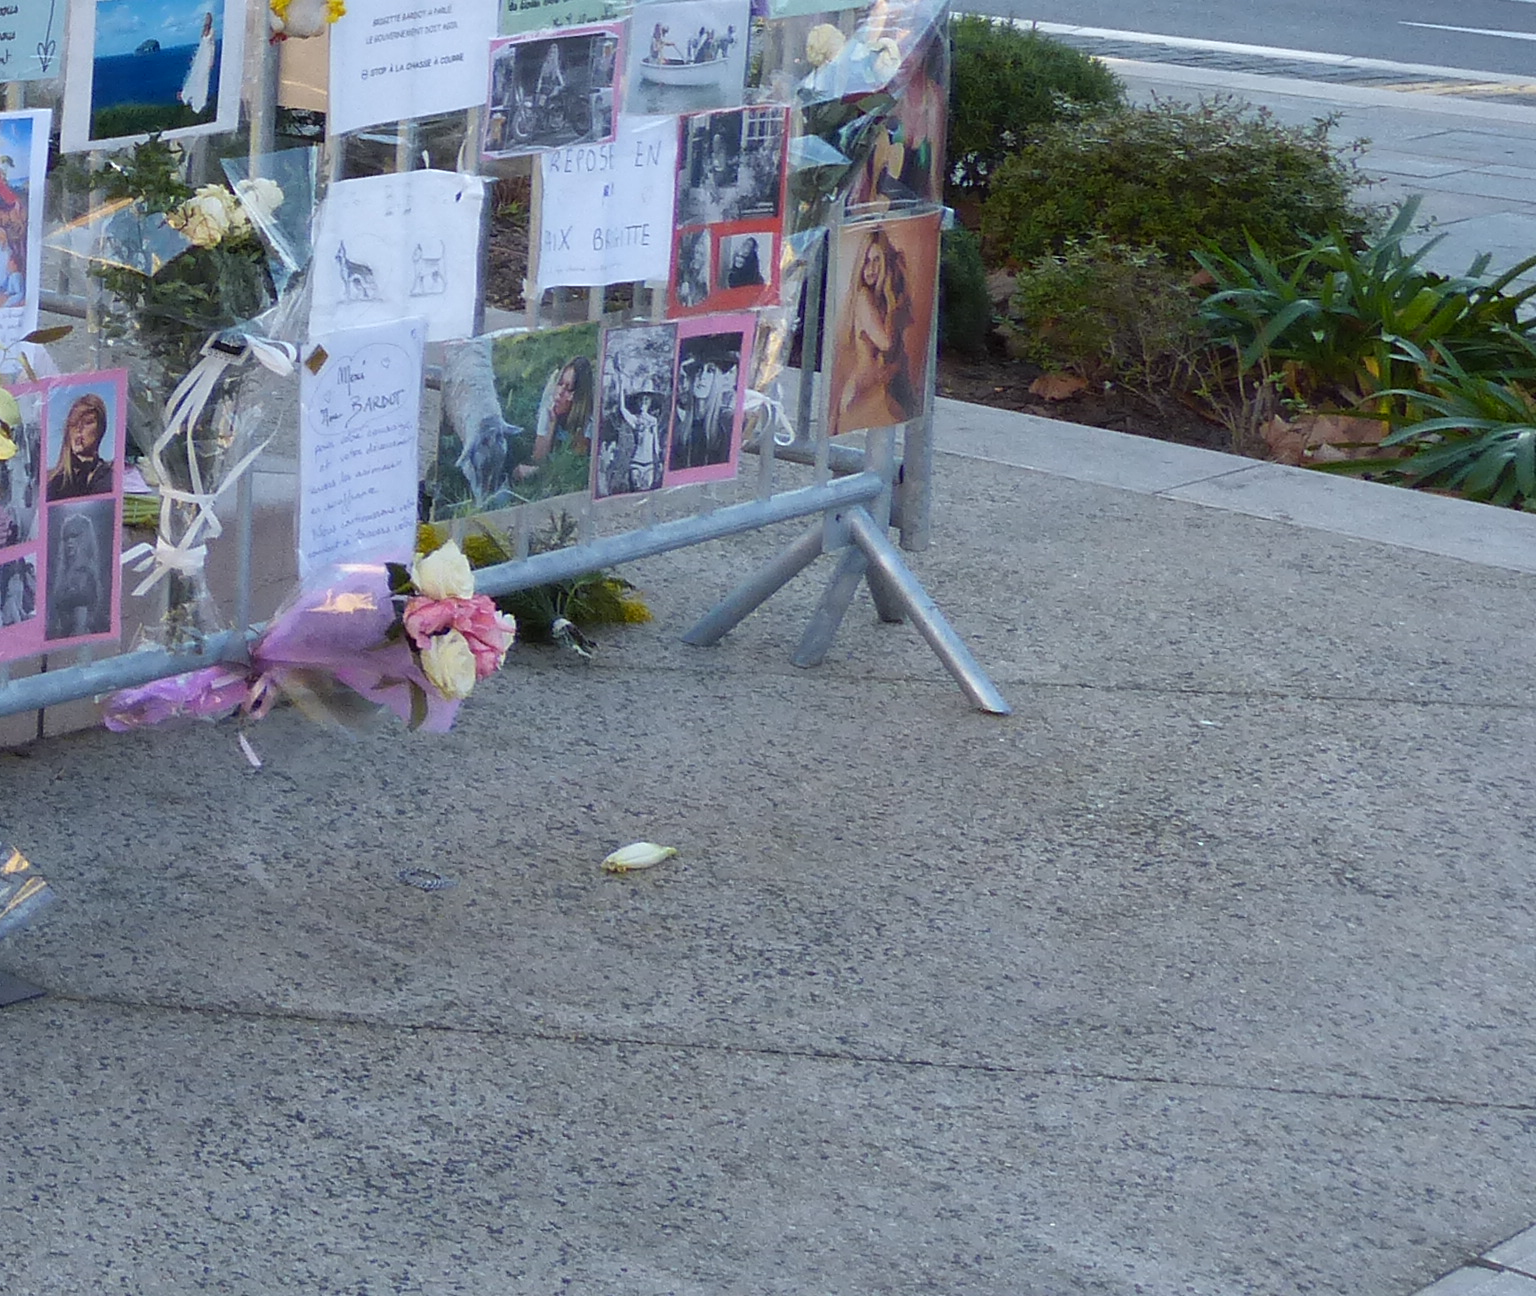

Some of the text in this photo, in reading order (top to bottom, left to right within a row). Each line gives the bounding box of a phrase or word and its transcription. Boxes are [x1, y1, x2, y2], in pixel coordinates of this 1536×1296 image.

[370, 66, 386, 77] STOP
[395, 64, 404, 72] LA
[405, 58, 432, 70] CHASSE
[549, 140, 662, 173] REPOSE EN
[345, 389, 405, 428] BARDOT
